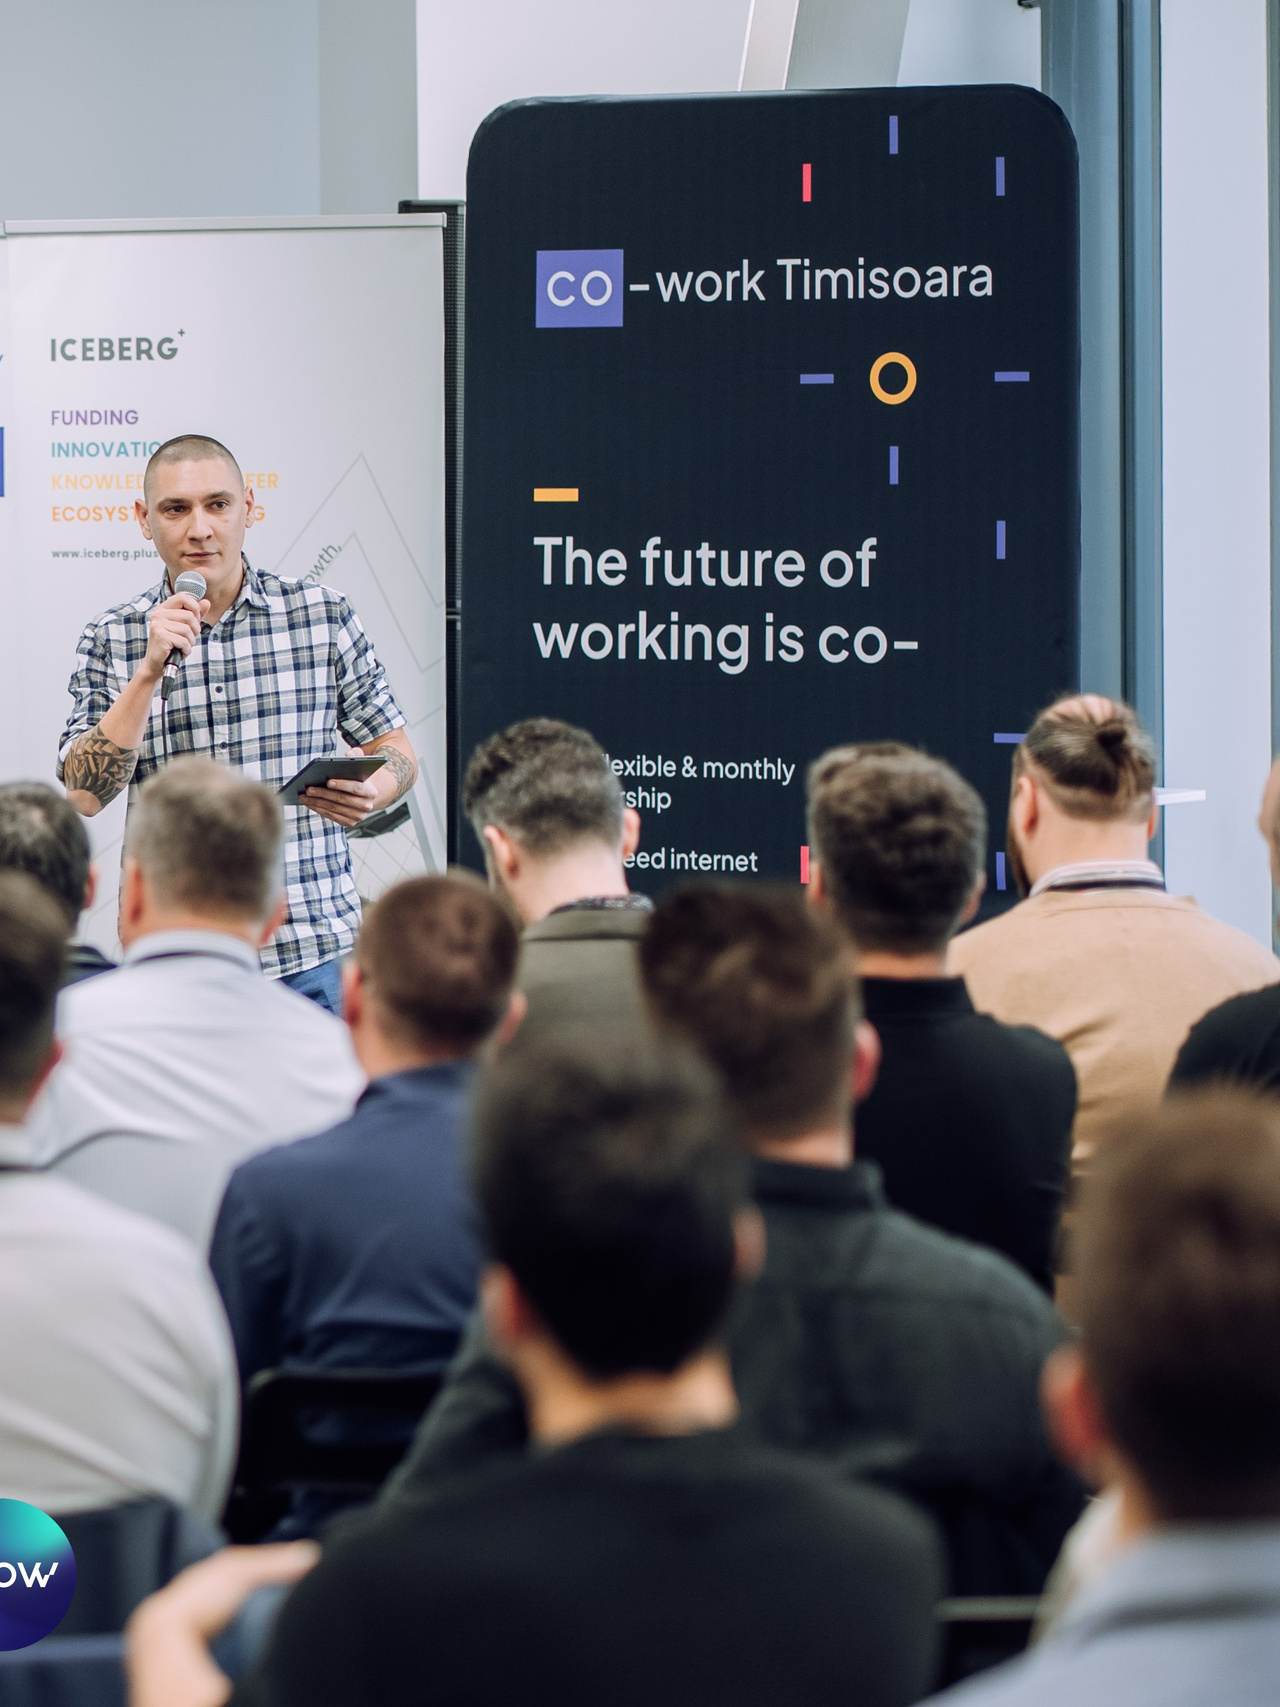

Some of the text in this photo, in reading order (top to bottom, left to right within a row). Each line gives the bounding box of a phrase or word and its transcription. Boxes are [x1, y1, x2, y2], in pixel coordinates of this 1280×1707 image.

[775, 255, 993, 303] Timisoara
[51, 409, 139, 426] FUNDING
[532, 535, 878, 590] The future of
[532, 609, 919, 676] working is co-
[681, 755, 698, 779] &
[702, 756, 796, 787] monthly
[670, 848, 759, 873] internet
